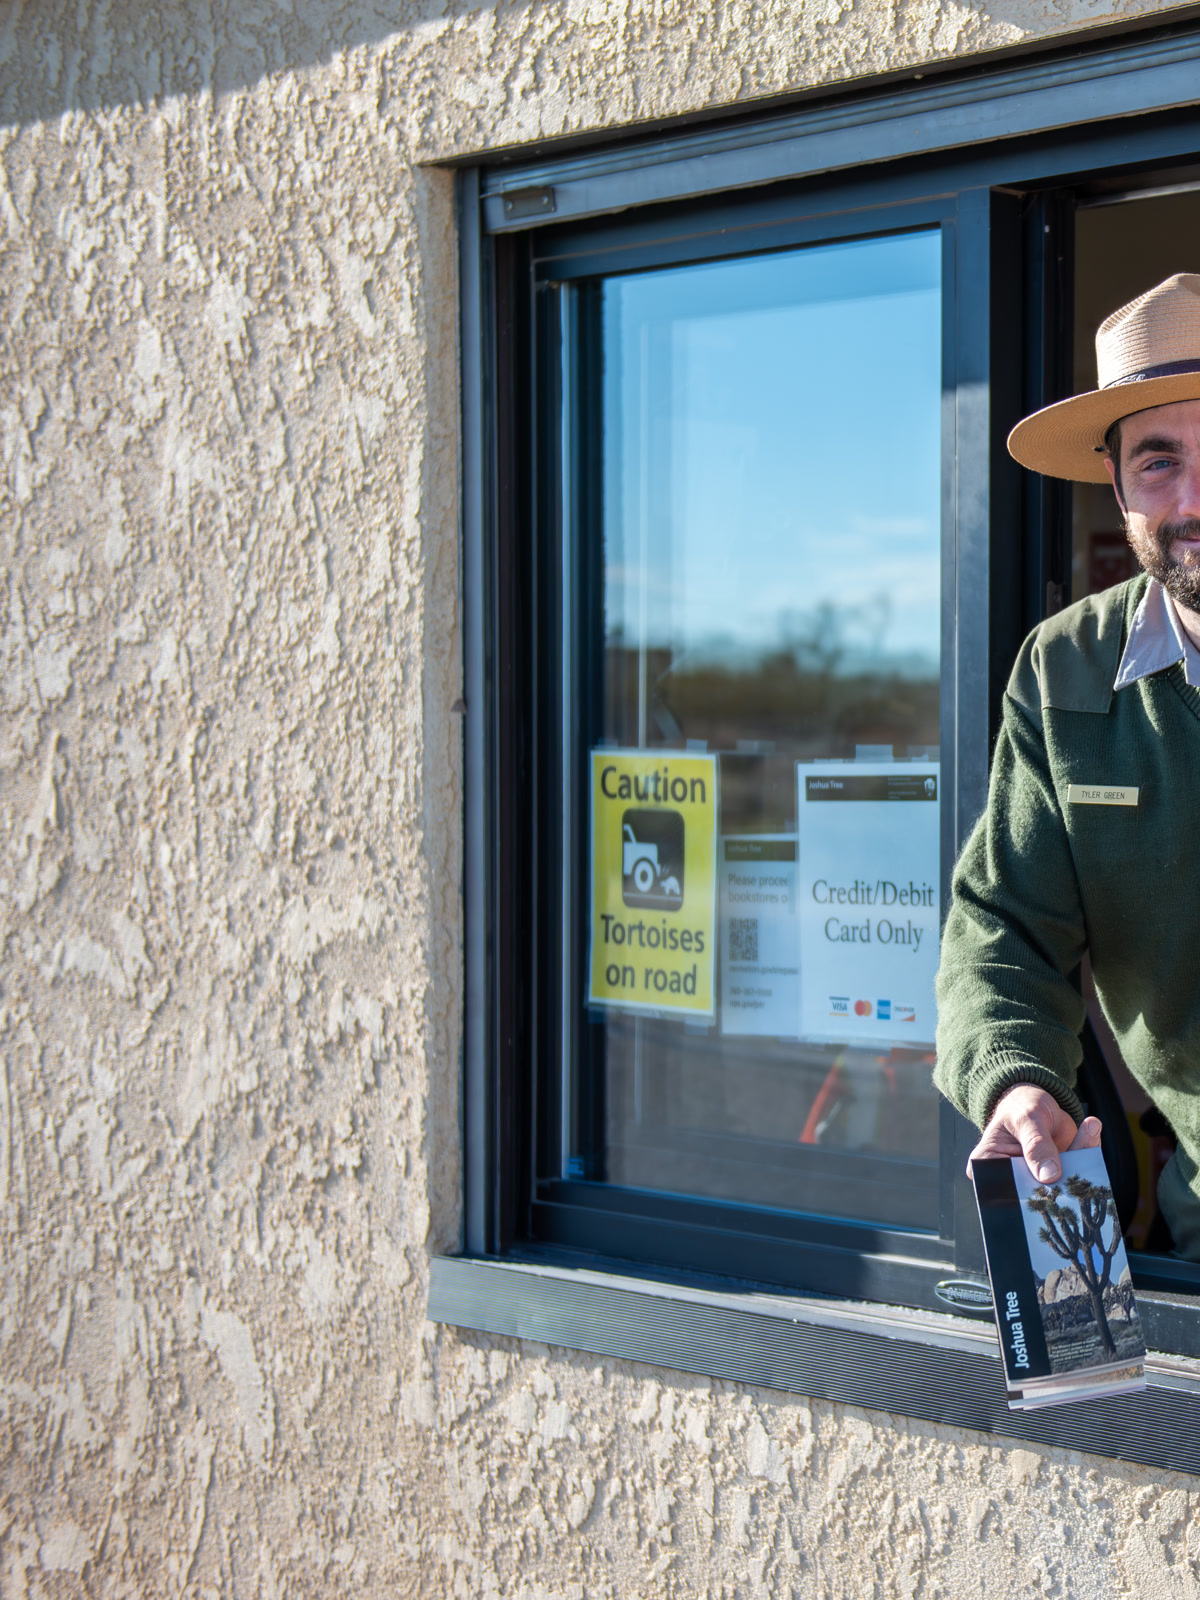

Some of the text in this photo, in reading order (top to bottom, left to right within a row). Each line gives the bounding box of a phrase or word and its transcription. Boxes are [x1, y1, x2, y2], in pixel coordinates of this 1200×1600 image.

[601, 765, 706, 804] Caution
[809, 780, 844, 790] Joshua Tree
[1081, 790, 1126, 800] TYLER GREEN
[728, 873, 756, 886] Please
[812, 879, 935, 908] Credit/Debit
[728, 889, 779, 904] bookstores
[601, 914, 705, 953] Tortoises
[824, 917, 924, 952] Card Only
[605, 963, 698, 996] on road
[832, 1001, 848, 1012] VISA
[1006, 1291, 1030, 1369] Joshua Tree
